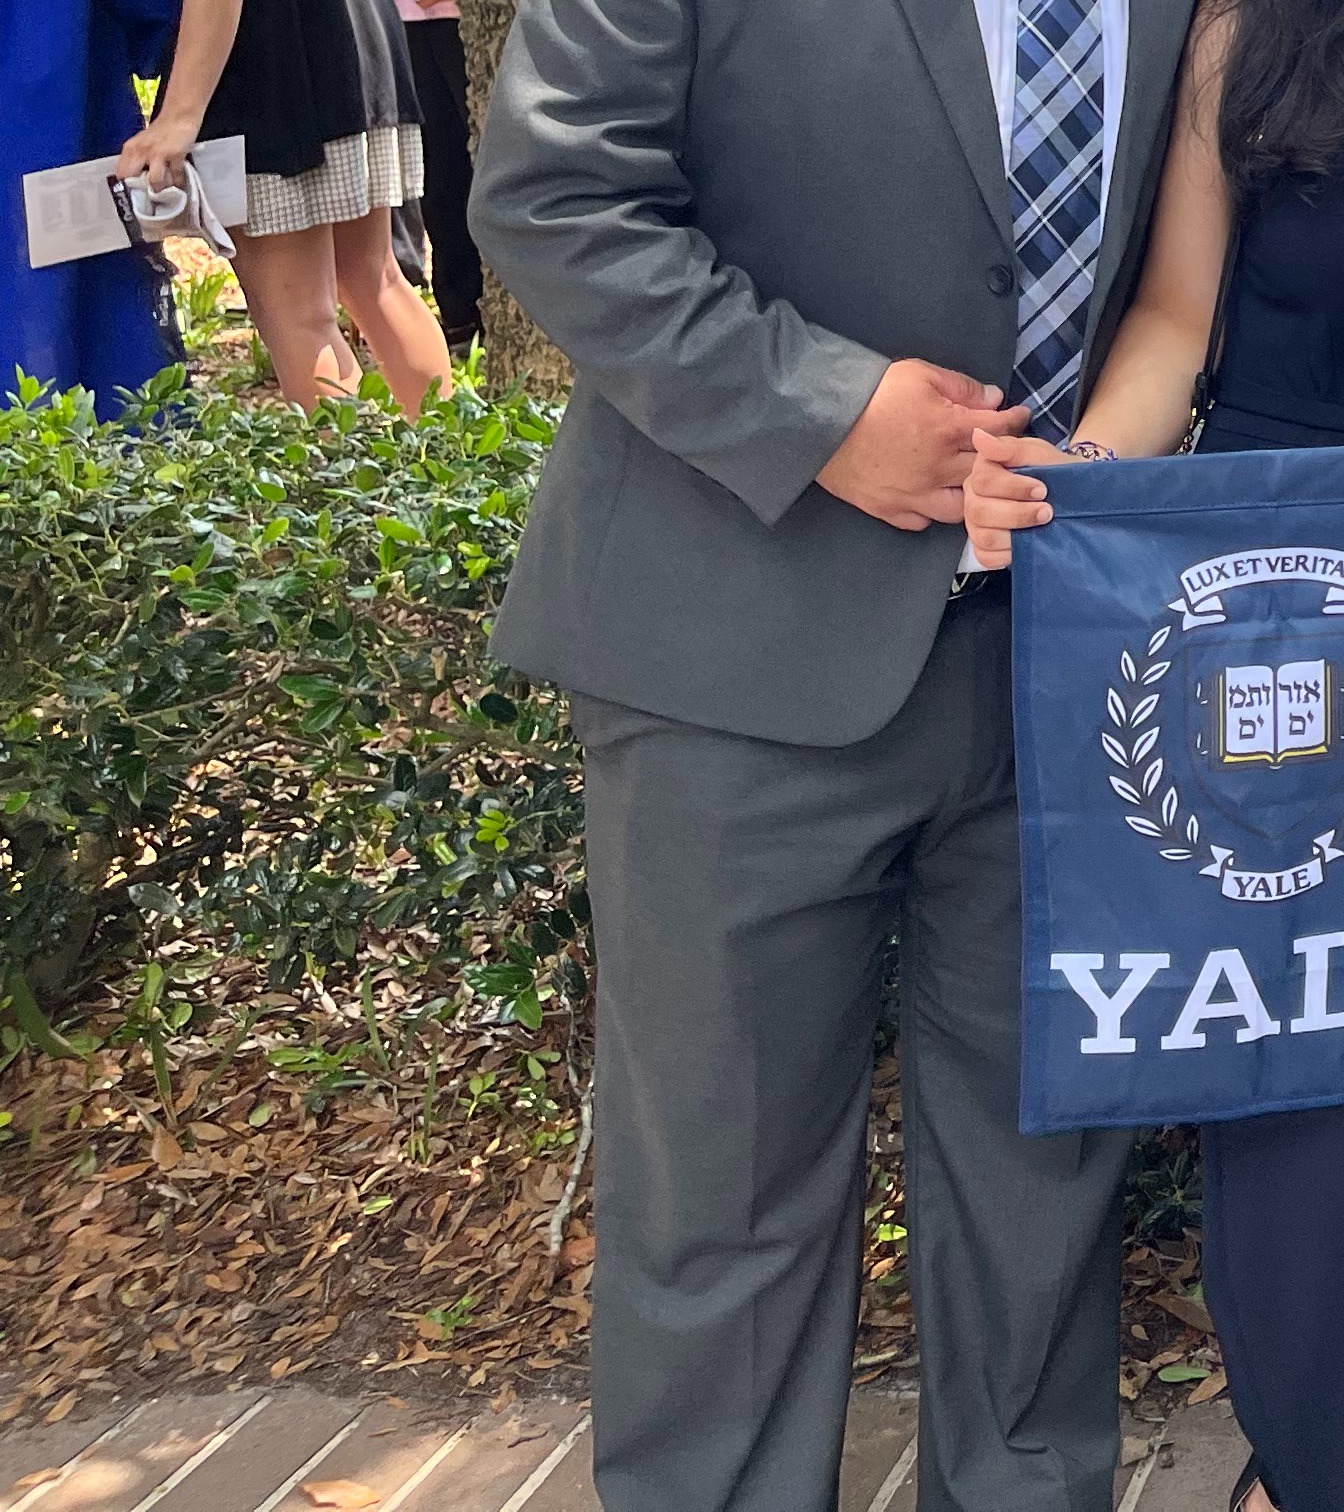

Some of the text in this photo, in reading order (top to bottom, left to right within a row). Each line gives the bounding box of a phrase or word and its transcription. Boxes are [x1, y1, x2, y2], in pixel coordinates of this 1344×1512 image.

[1185, 562, 1231, 593] LUX
[1233, 557, 1262, 578] ET
[1233, 867, 1312, 899] YALE
